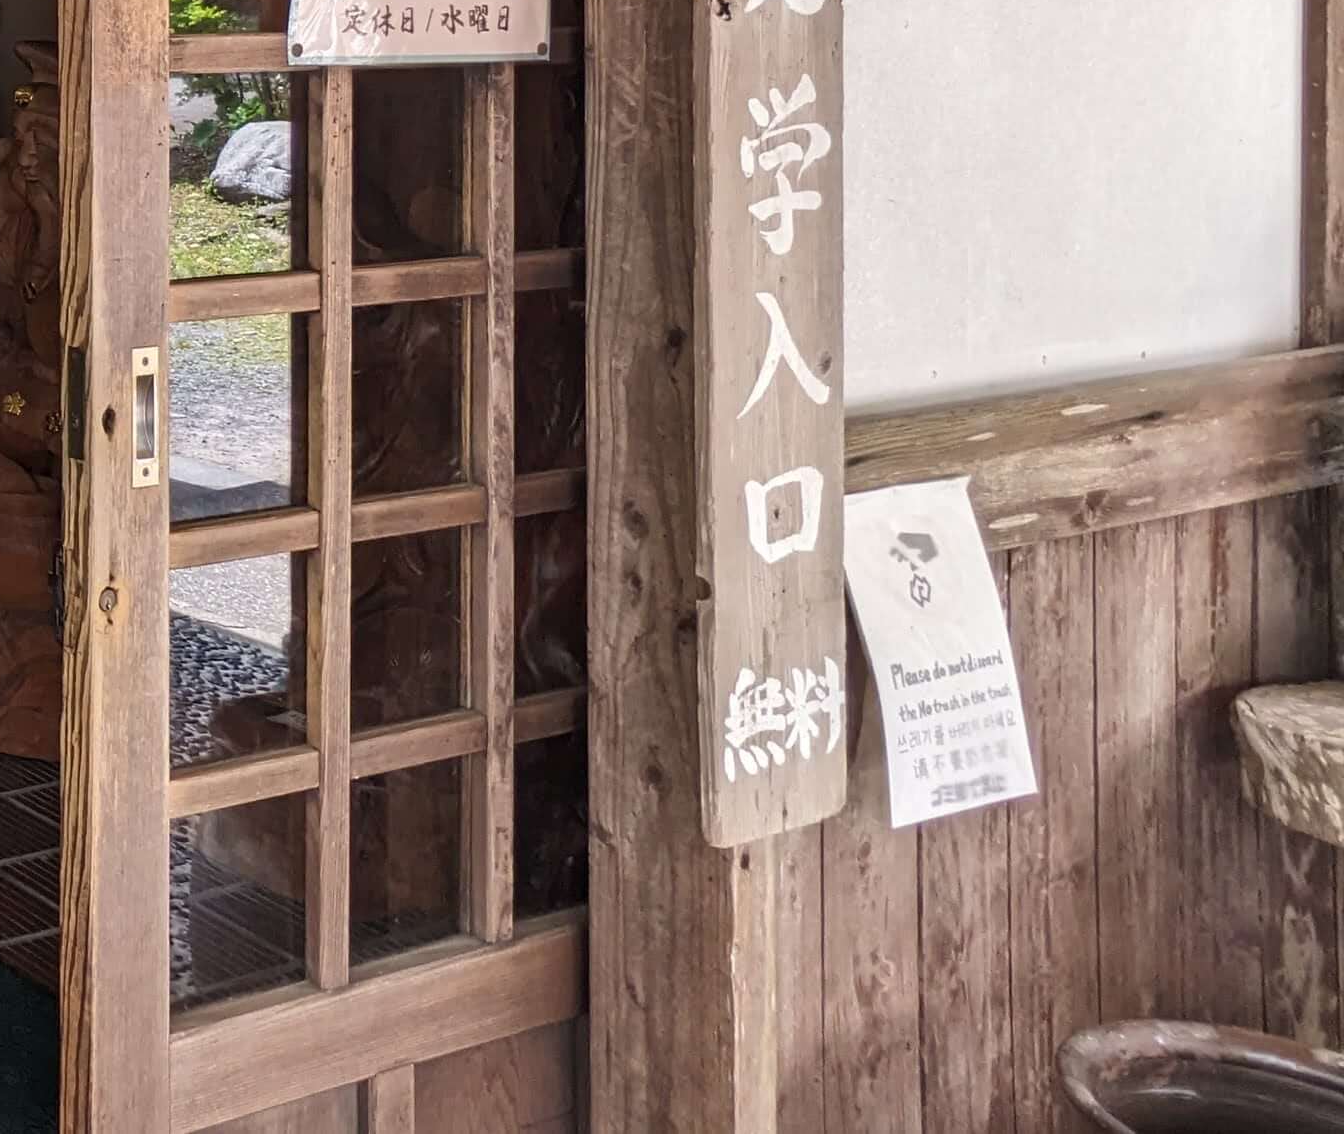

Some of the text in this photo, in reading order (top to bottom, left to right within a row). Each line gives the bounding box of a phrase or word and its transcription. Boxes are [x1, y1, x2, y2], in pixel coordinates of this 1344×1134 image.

[890, 662, 932, 691] Please
[933, 660, 947, 680] do
[949, 656, 968, 677] not
[724, 657, 845, 782] 無料
[898, 703, 917, 723] the
